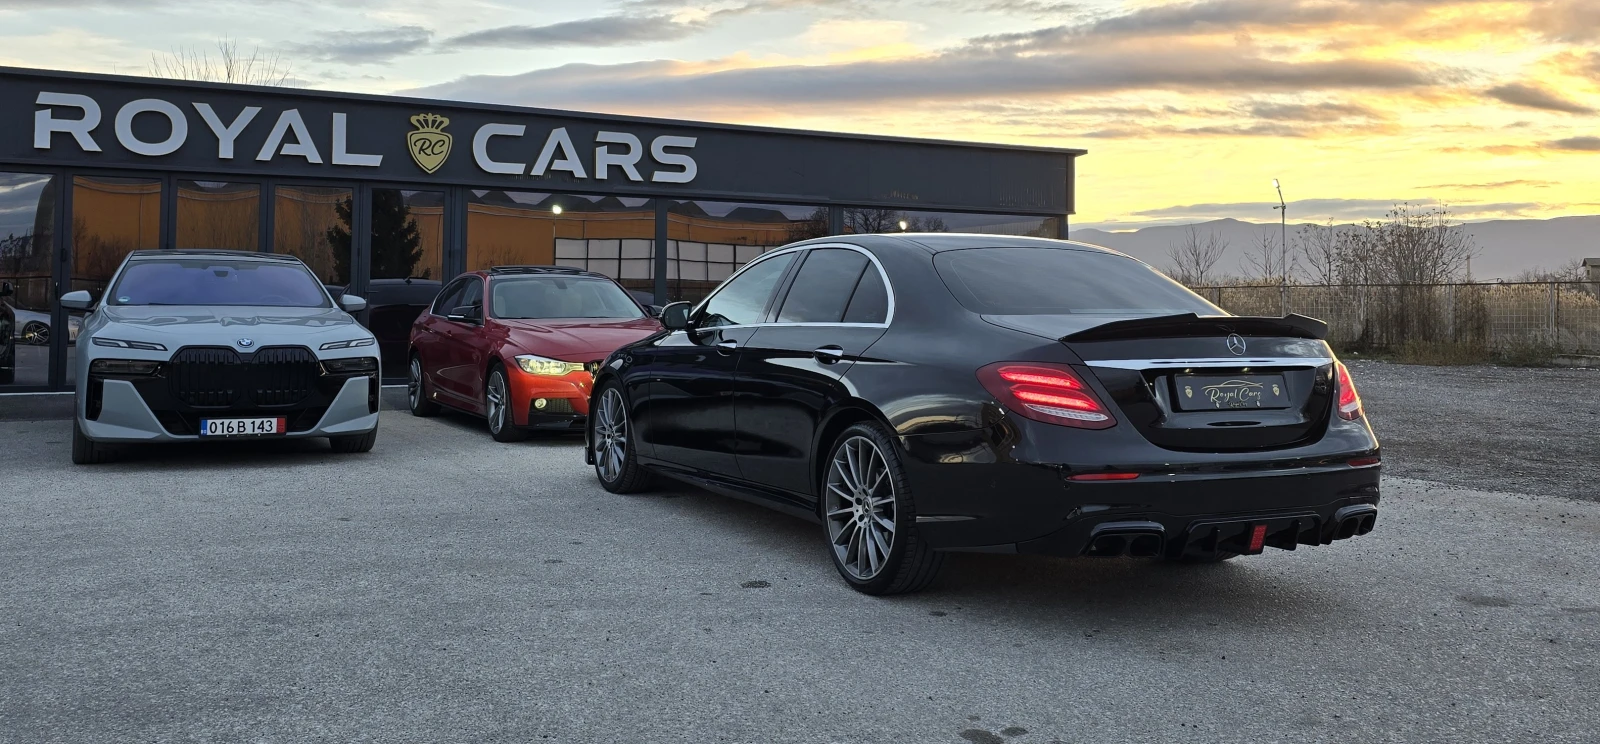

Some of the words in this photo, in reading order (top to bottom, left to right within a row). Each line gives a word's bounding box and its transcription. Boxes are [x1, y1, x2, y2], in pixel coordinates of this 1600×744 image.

[34, 91, 383, 167] ROYAL
[472, 123, 698, 182] CARS
[413, 137, 446, 156] RC
[1205, 387, 1238, 402] Royal
[209, 421, 235, 434] 016
[237, 420, 247, 433] B
[250, 420, 273, 433] 143
